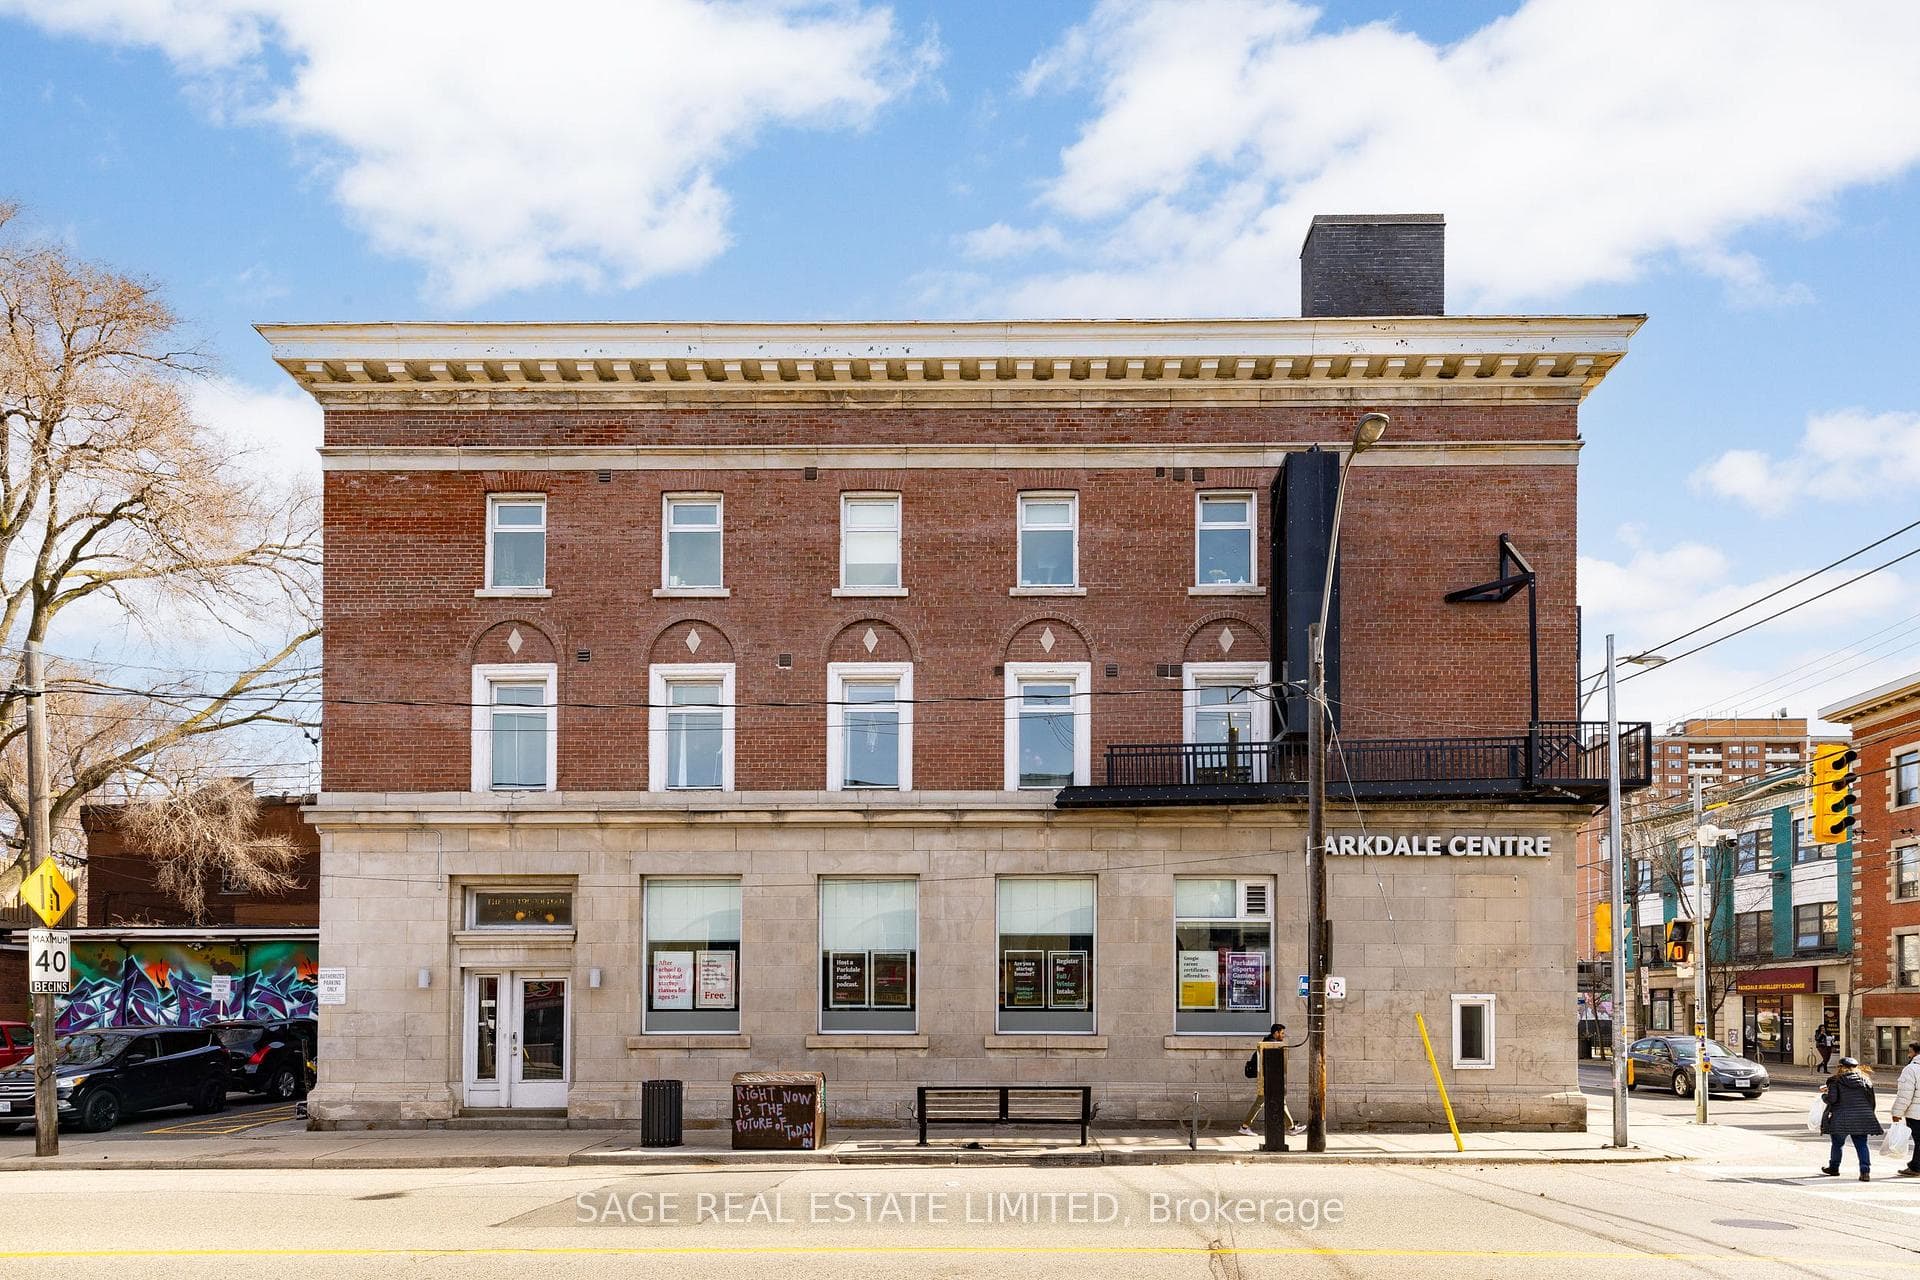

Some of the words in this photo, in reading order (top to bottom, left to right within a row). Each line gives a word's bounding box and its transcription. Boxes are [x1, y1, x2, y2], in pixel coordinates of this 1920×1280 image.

[1324, 835, 1441, 857] ARKDALE
[1448, 836, 1552, 857] CENTRE
[33, 935, 67, 944] MAXIMUM
[35, 950, 66, 972] 40
[34, 982, 68, 992] BEGINS
[703, 991, 727, 1000] Free.
[758, 1102, 783, 1117] THE
[735, 1117, 773, 1133] FUTURE
